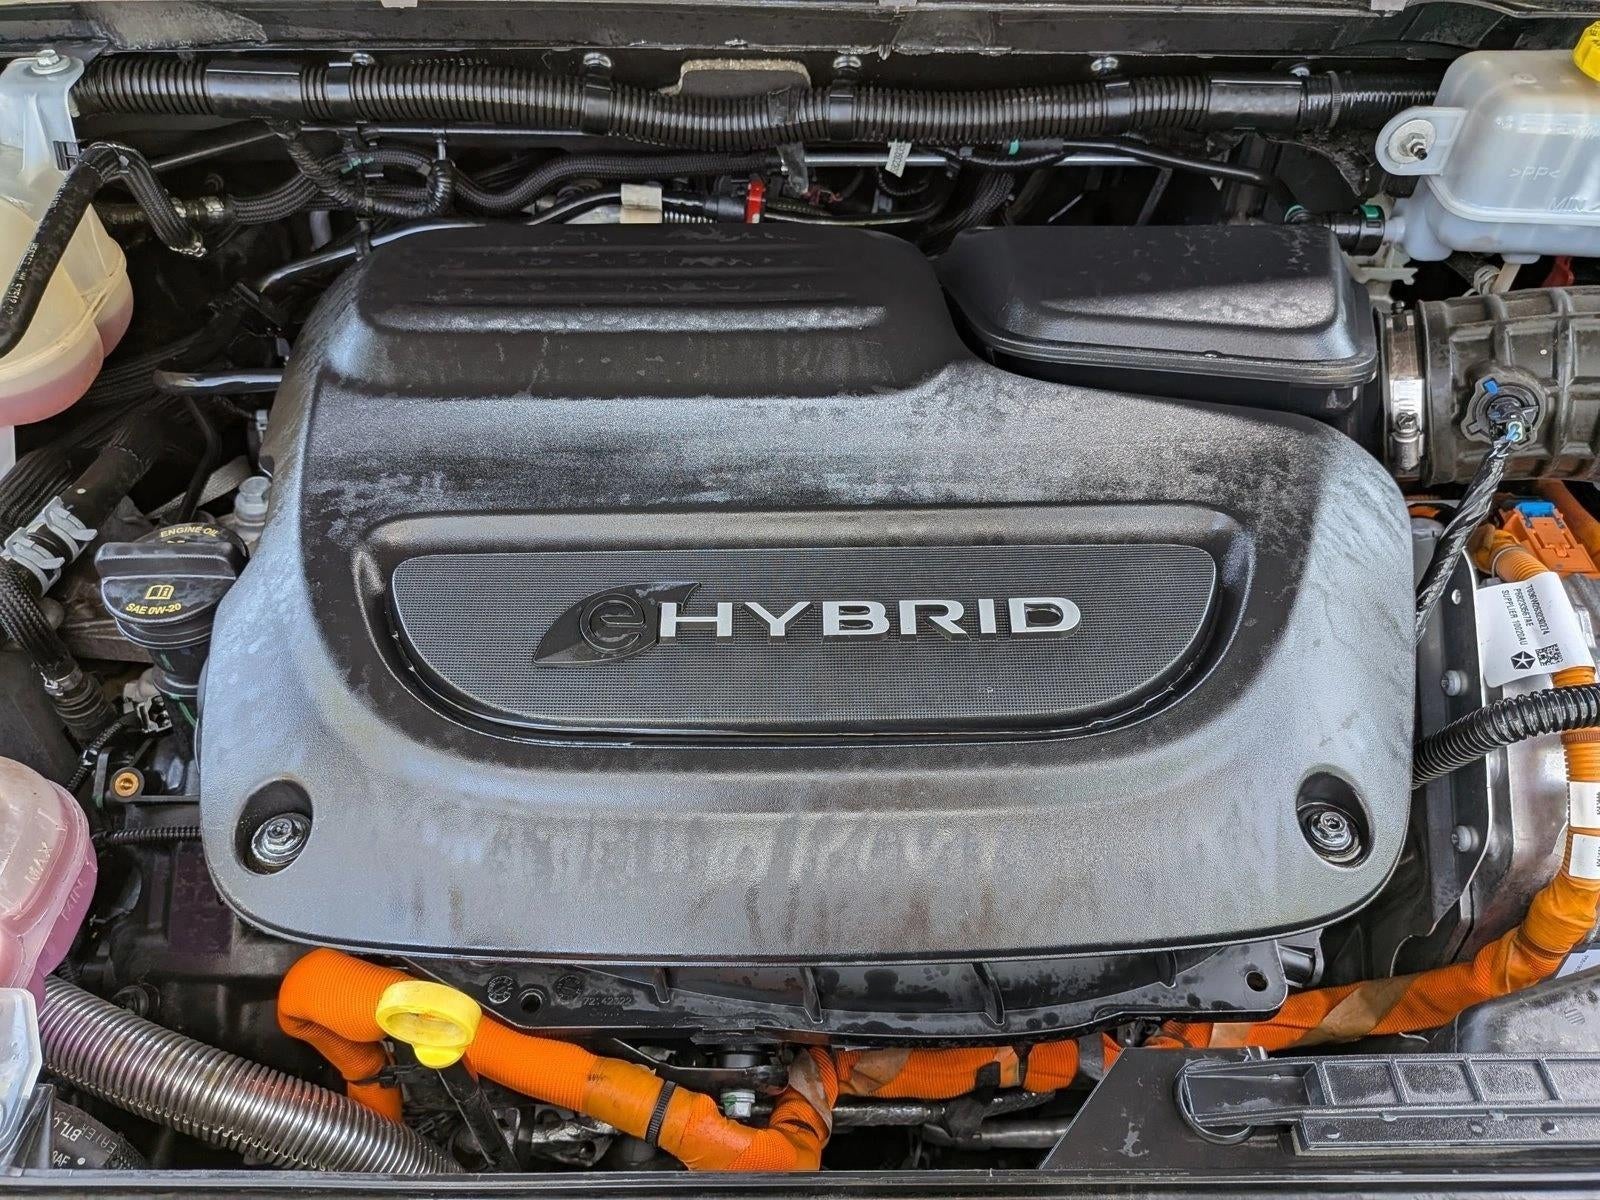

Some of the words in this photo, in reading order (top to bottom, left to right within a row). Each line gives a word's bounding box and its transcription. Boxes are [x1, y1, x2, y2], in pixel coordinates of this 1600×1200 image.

[160, 526, 202, 538] ENGINE
[203, 527, 220, 538] OIL
[125, 603, 147, 615] SAE
[147, 603, 182, 615] 0W-20
[1501, 589, 1518, 619] SUPPLIER
[24, 841, 53, 884] MAX
